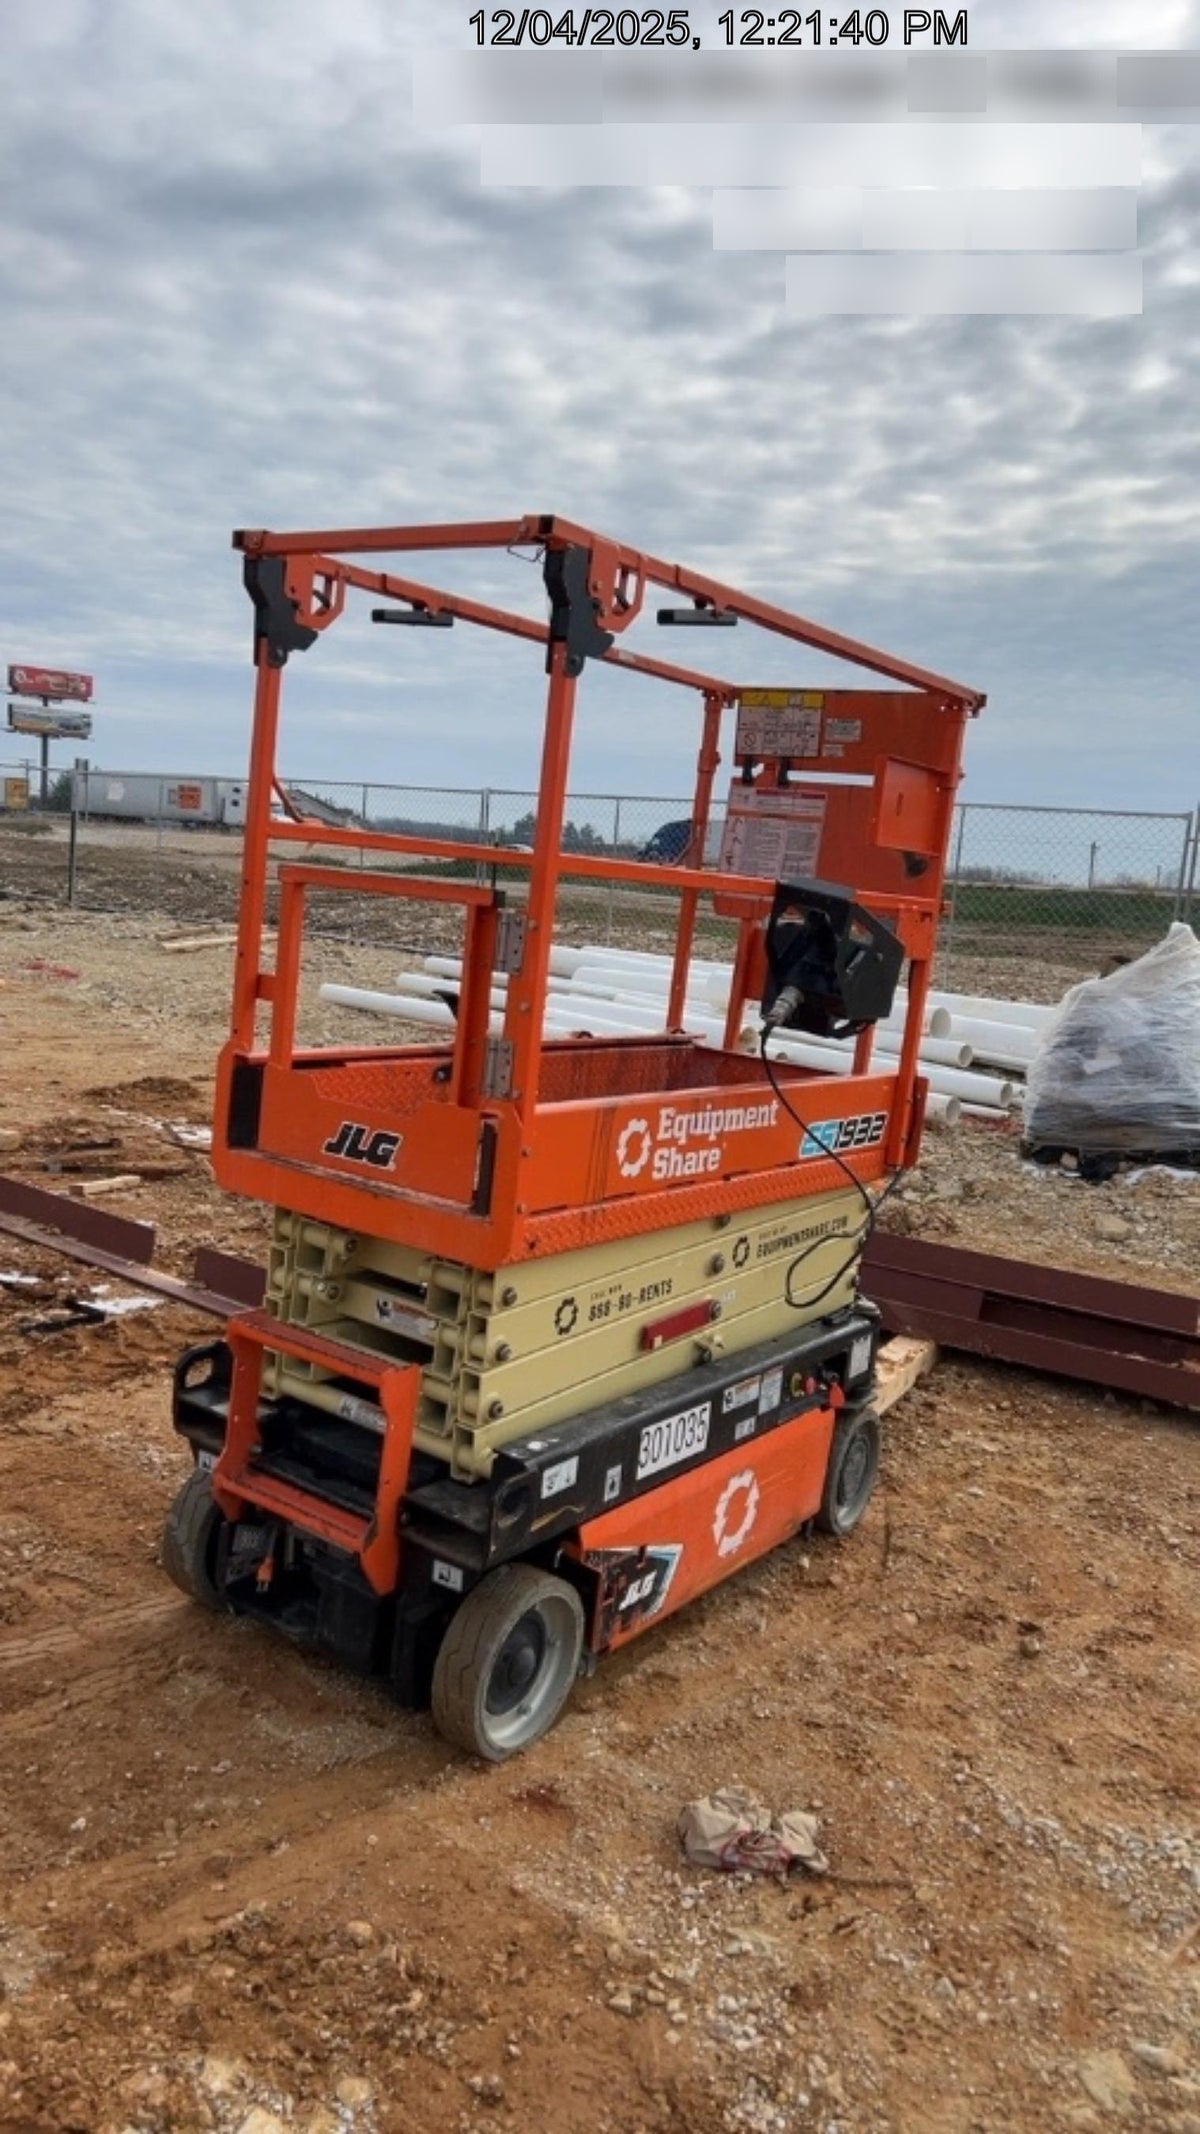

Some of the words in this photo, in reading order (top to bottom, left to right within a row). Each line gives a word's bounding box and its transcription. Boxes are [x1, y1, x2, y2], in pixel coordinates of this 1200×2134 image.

[656, 1099, 779, 1145] Equipment
[799, 1111, 888, 1158] ES1932
[322, 1121, 403, 1170] JLG
[651, 1147, 721, 1180] Share
[639, 1405, 708, 1469] 301035
[618, 1569, 658, 1612] JLG
